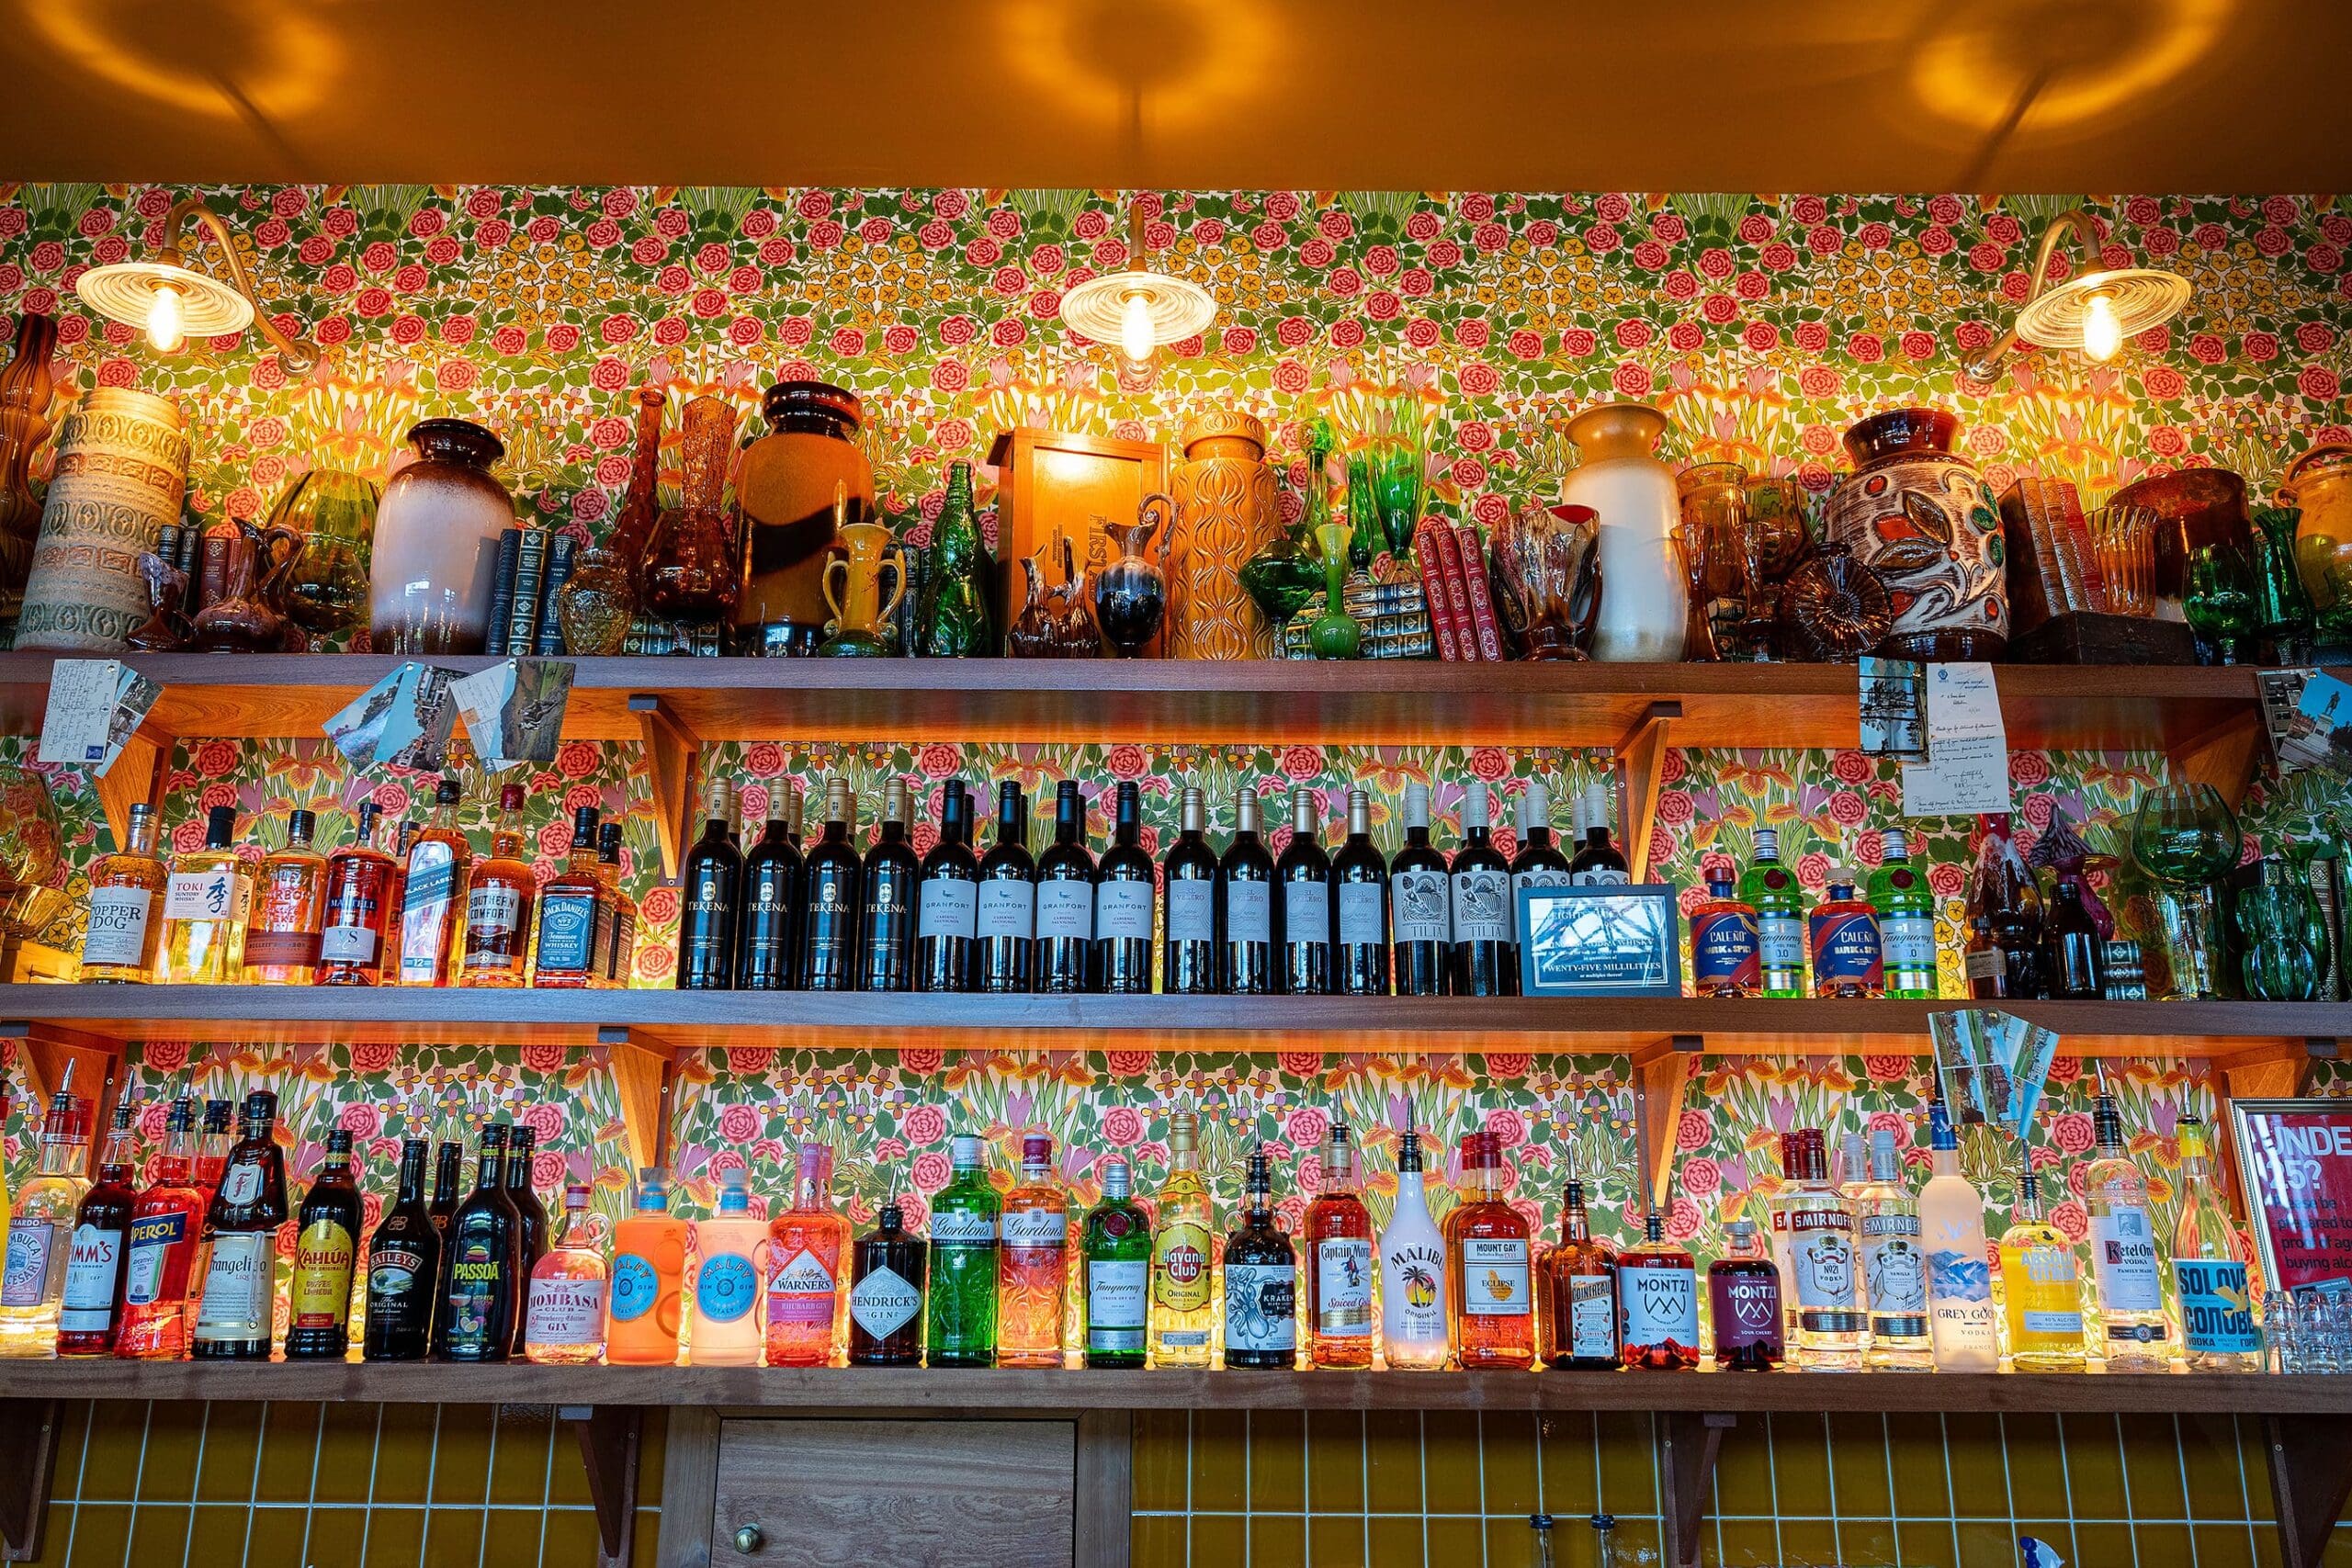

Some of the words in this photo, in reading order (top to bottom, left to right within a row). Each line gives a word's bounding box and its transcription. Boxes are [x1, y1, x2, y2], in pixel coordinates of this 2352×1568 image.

[1089, 514, 1107, 568] FIRST
[175, 883, 203, 891] TOKI
[430, 876, 455, 887] LABEL
[206, 876, 229, 913] 季
[331, 899, 375, 908] MATELL
[470, 896, 514, 908] SOUTHERN
[688, 901, 729, 913] TEKENA
[748, 902, 787, 914] TEKENA
[809, 903, 850, 914] TEKENA
[926, 901, 970, 909] GRANFORT
[983, 902, 1027, 910] GRANFORT
[470, 908, 511, 919] COMFORT
[544, 904, 560, 918] JACK
[561, 902, 589, 918] DANIEL'S
[866, 903, 907, 915] TEKENA
[93, 916, 127, 930] DOG
[1411, 926, 1442, 937] TILIA
[1469, 926, 1502, 937] TILIA
[1710, 931, 1747, 942] CALEÑO
[1758, 932, 1801, 944] Tanqueray
[1883, 932, 1932, 943] Tanqueray
[1834, 946, 1860, 954] DARK
[413, 958, 424, 966] 12
[2273, 1126, 2352, 1156] UNDE
[2267, 1159, 2323, 1190] 25?
[2273, 1196, 2317, 1210] Pease
[2321, 1196, 2337, 1209] be
[934, 1217, 990, 1236] Gordon's
[1008, 1217, 1064, 1237] Gordon's
[2278, 1216, 2338, 1232] prepared
[8, 1232, 41, 1257] MBUCA
[1476, 1244, 1502, 1252] MOUNT
[1504, 1244, 1517, 1252] GAY
[2107, 1242, 2139, 1259] Ketel
[2141, 1243, 2154, 1257] One
[2335, 1239, 2352, 1251] ag
[71, 1240, 112, 1263] IMM'S
[297, 1246, 350, 1270] KAHLÚA
[1163, 1249, 1205, 1263] Havana
[1321, 1245, 1351, 1260] Captain
[209, 1251, 266, 1275] rangelio
[370, 1252, 416, 1267] BAILEYS
[1391, 1247, 1445, 1271] MALIBU
[2021, 1251, 2075, 1266] ABSOLU
[2286, 1256, 2330, 1271] buying
[6, 1261, 41, 1285] CESARI
[454, 1261, 500, 1280] PASSOÃ
[614, 1258, 651, 1279] ALFY
[704, 1258, 752, 1280] MALFY
[1170, 1263, 1197, 1277] Club
[778, 1280, 831, 1290] WARNER'S
[1095, 1280, 1141, 1293] Tanqueray
[1637, 1279, 1690, 1292] MONTZI
[2178, 1268, 2247, 1296] SOLOV
[1168, 1290, 1201, 1298] ORIGINAL
[1263, 1294, 1295, 1303] KRAKEN
[1728, 1286, 1777, 1299] MONTZI
[530, 1293, 598, 1310] MOMBASA
[852, 1295, 918, 1307] HENDRICK'S
[1329, 1298, 1357, 1309] Spiced
[1358, 1297, 1371, 1307] Gol
[871, 1311, 894, 1319] GIN
[1405, 1309, 1438, 1319] ORIGINAL
[1938, 1308, 1967, 1320] GREY
[1972, 1307, 1994, 1320] GOO
[548, 1323, 569, 1331] GIN
[2188, 1337, 2215, 1347] VODKA
